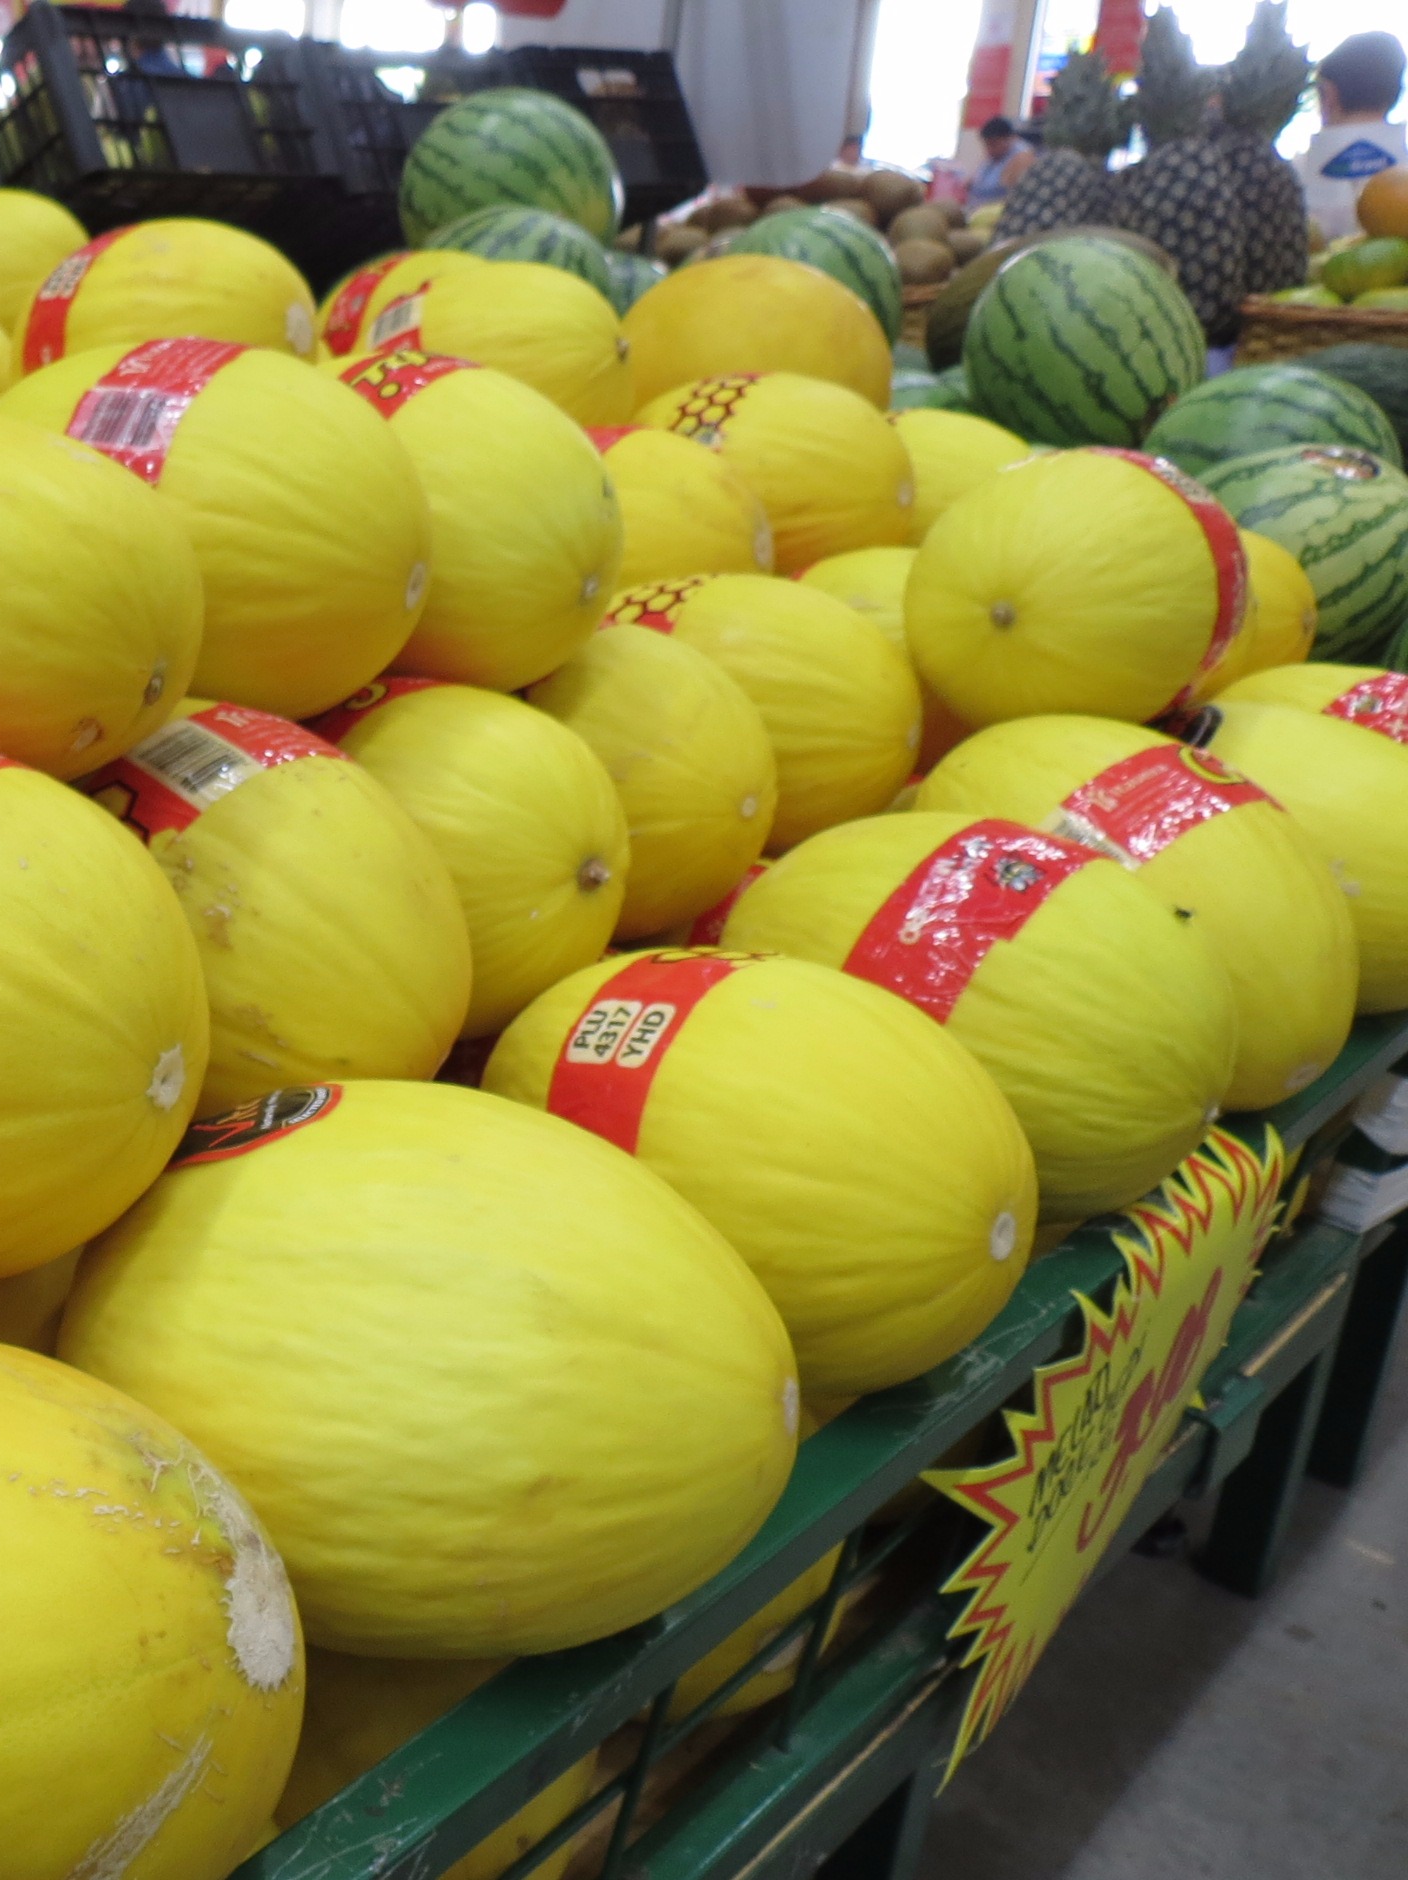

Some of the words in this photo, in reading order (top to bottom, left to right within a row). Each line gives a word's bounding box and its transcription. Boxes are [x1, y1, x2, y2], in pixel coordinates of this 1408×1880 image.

[573, 1009, 609, 1050] PLU
[593, 1006, 632, 1058] 4317
[620, 1010, 666, 1060] YHD
